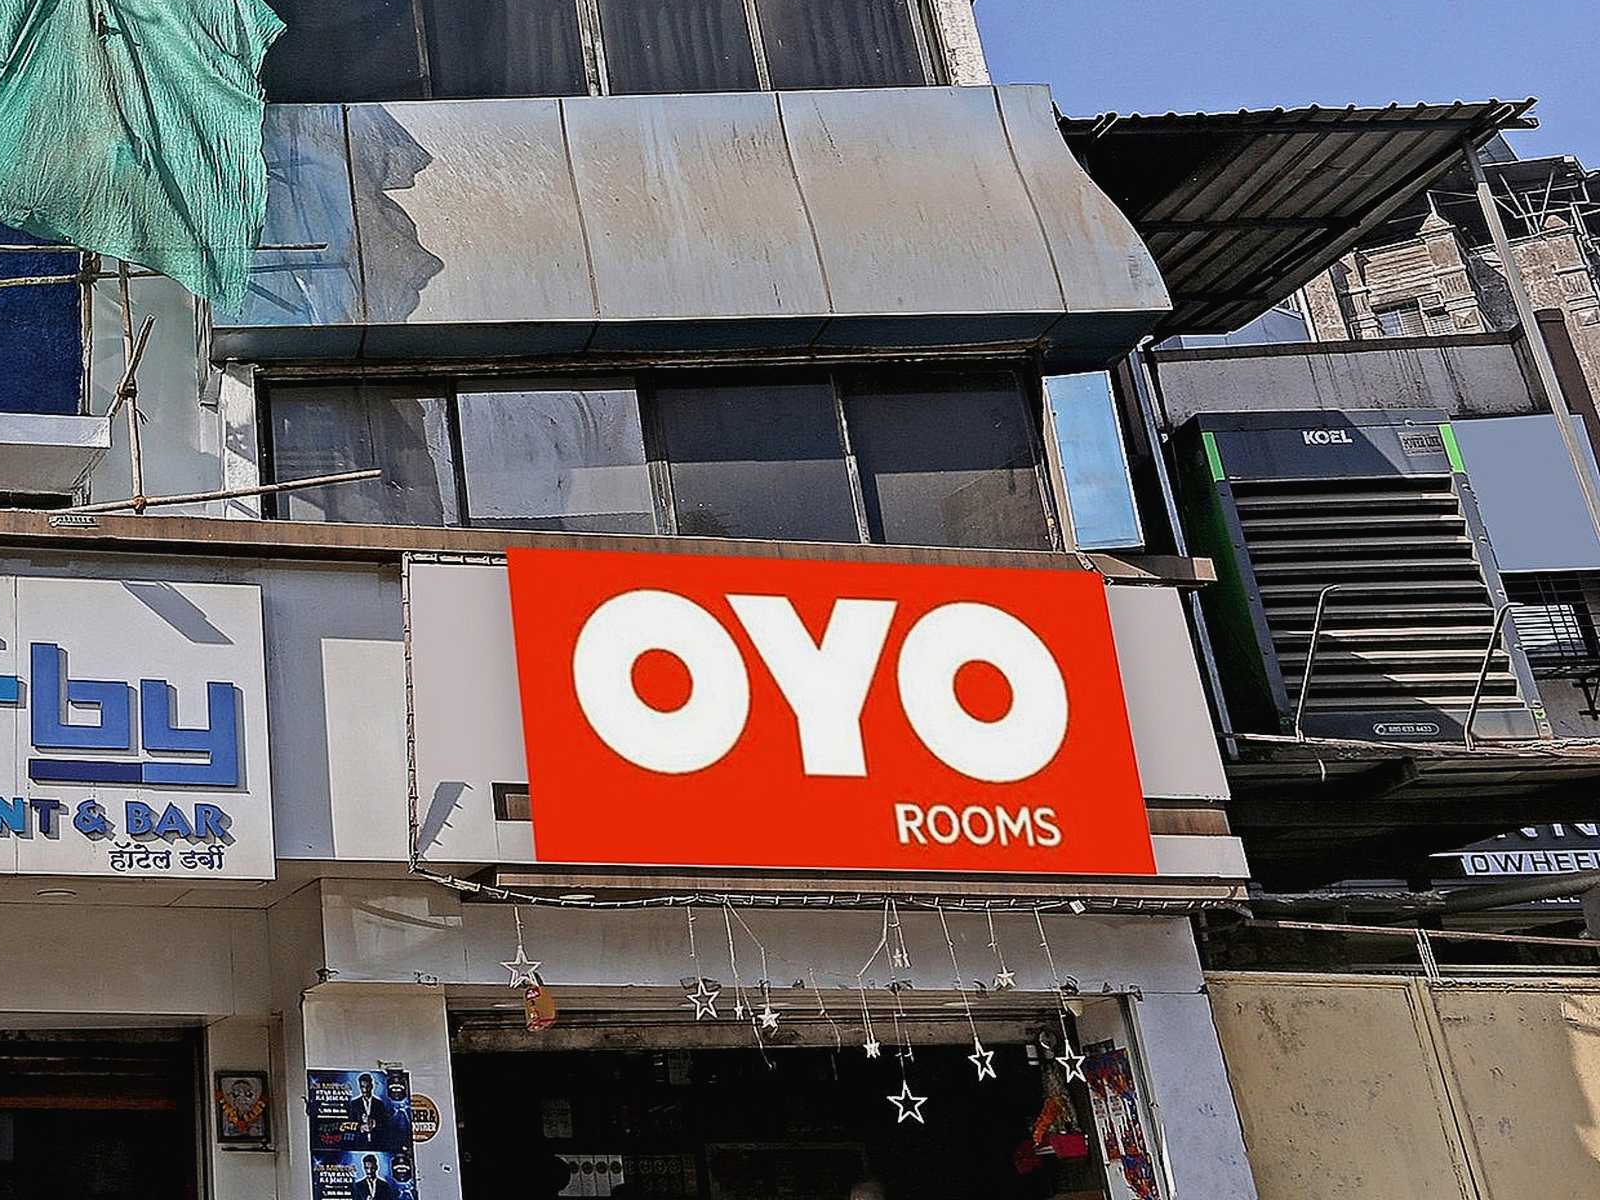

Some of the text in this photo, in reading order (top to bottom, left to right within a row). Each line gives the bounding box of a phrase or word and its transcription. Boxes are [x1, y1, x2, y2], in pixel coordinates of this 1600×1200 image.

[1302, 429, 1353, 445] KOEL
[572, 589, 1069, 784] OYO
[73, 798, 107, 833] &
[124, 799, 227, 838] BAR
[894, 802, 1062, 848] ROOMS
[108, 841, 226, 872] हॉटेल डर्बी
